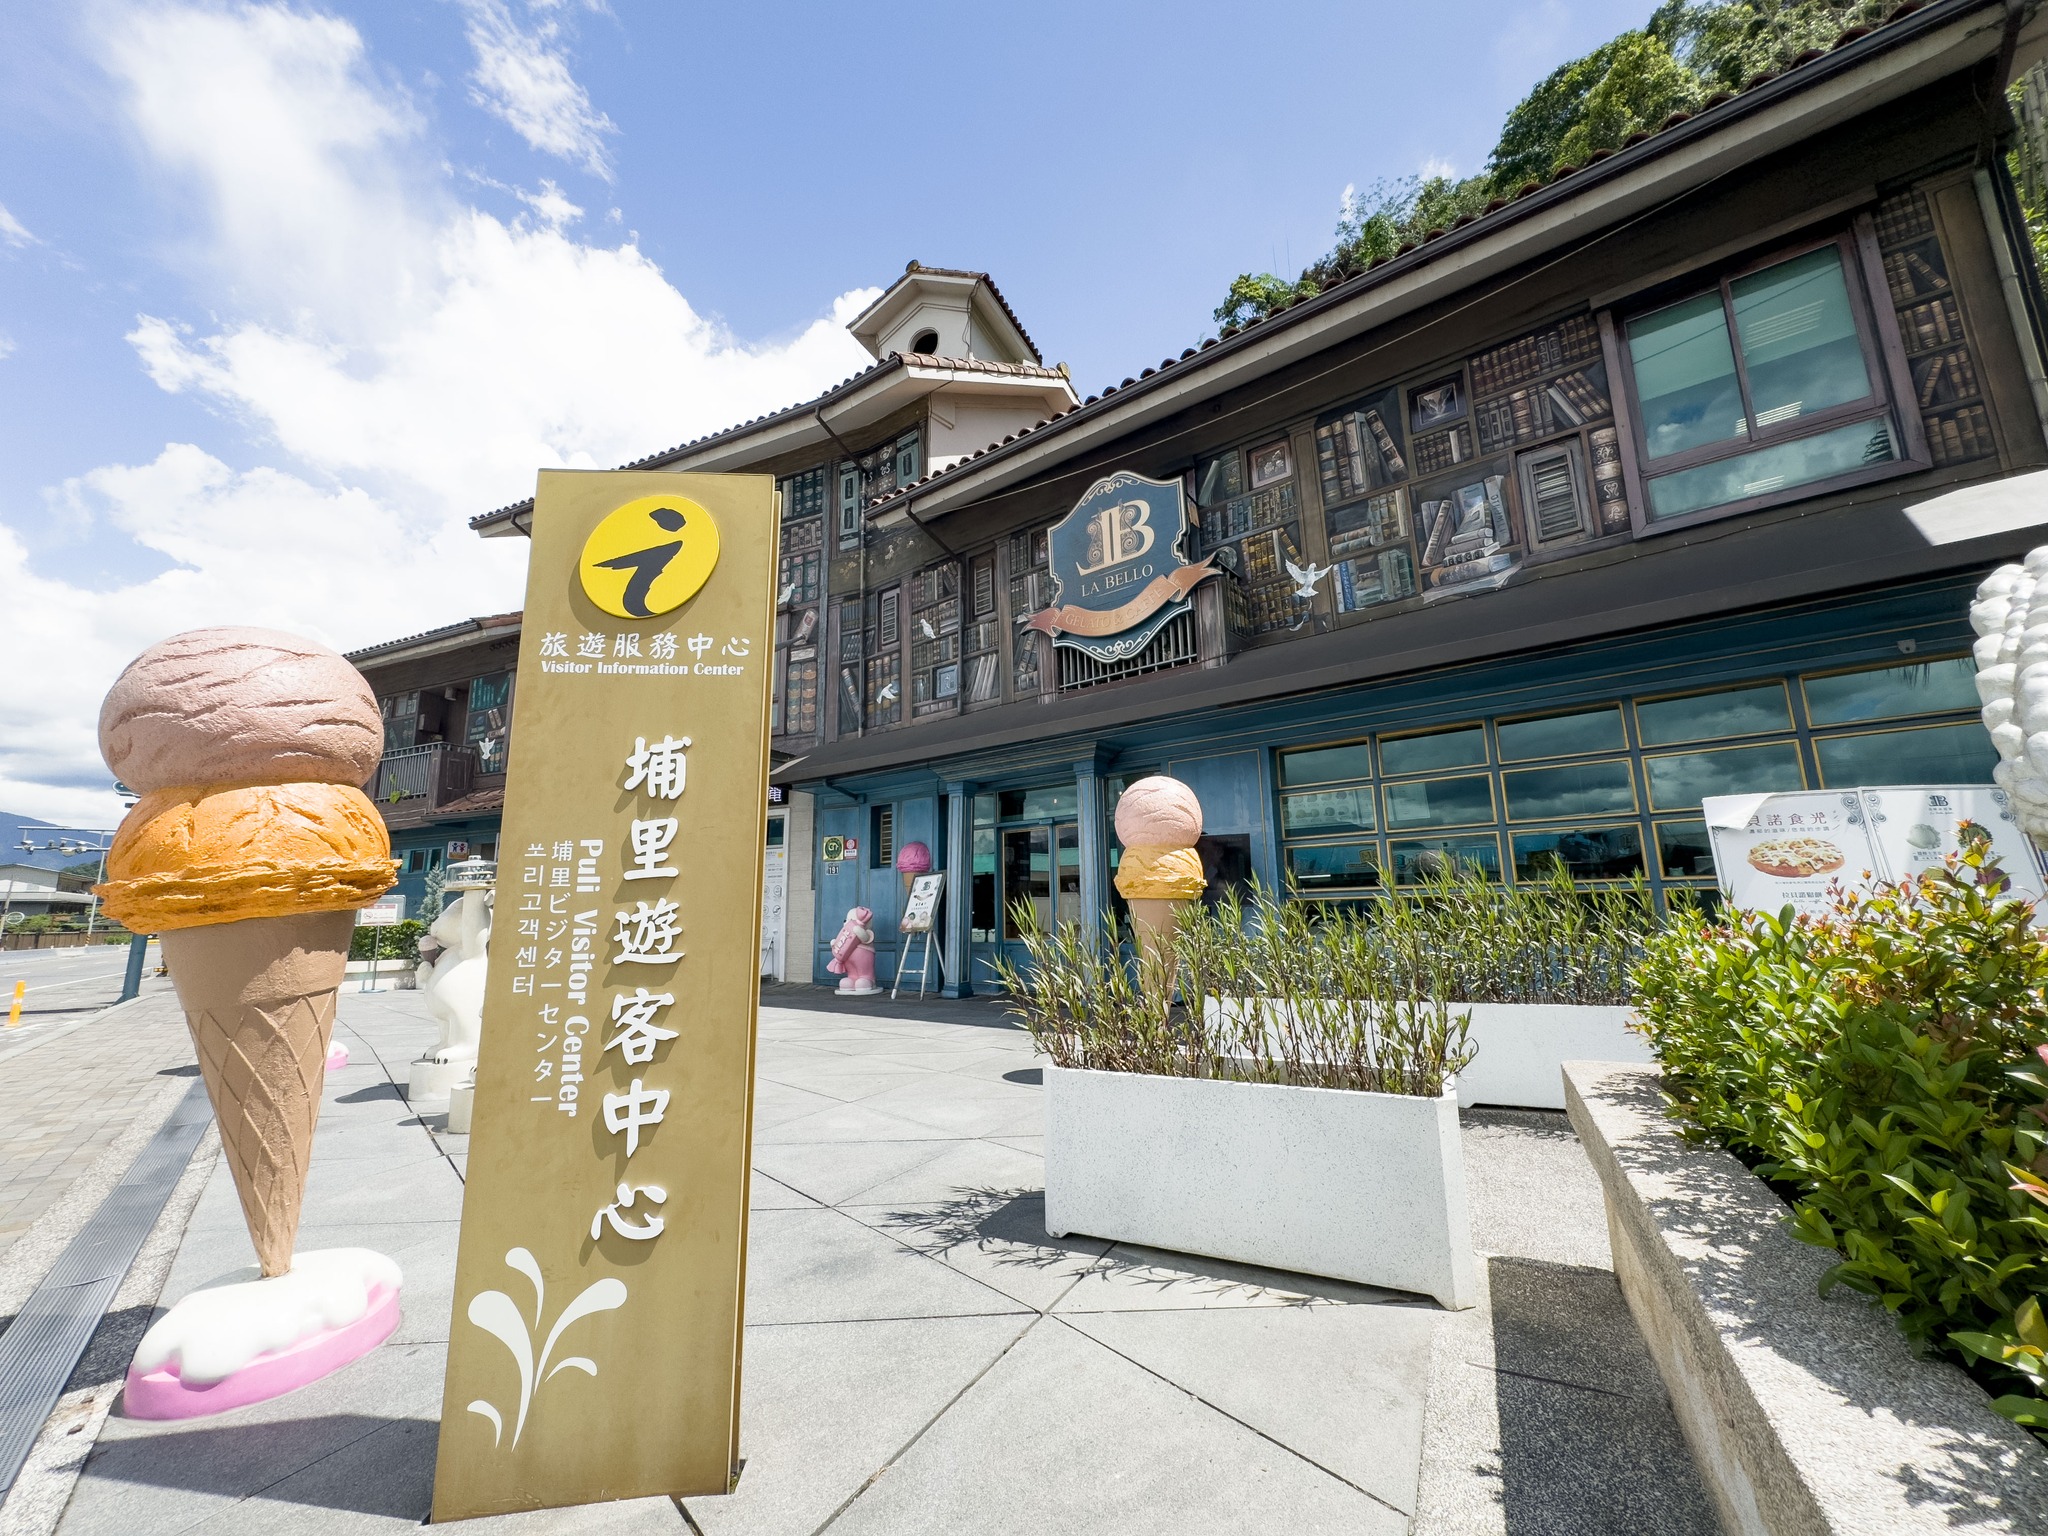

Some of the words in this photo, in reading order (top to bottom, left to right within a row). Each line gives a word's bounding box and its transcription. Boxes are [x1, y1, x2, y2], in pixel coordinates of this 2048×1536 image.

[1081, 582, 1099, 597] LA
[1105, 564, 1153, 589] BELLO
[1065, 614, 1111, 628] GELATO
[539, 632, 750, 660] 旅遊服務中心
[541, 660, 592, 674] Visitor
[597, 661, 688, 675] Information
[693, 662, 744, 676] Center
[576, 839, 603, 892] Puli
[568, 909, 598, 1005] Visitor
[590, 734, 693, 1241] 埔里遊客中心
[558, 1015, 590, 1118] Center
